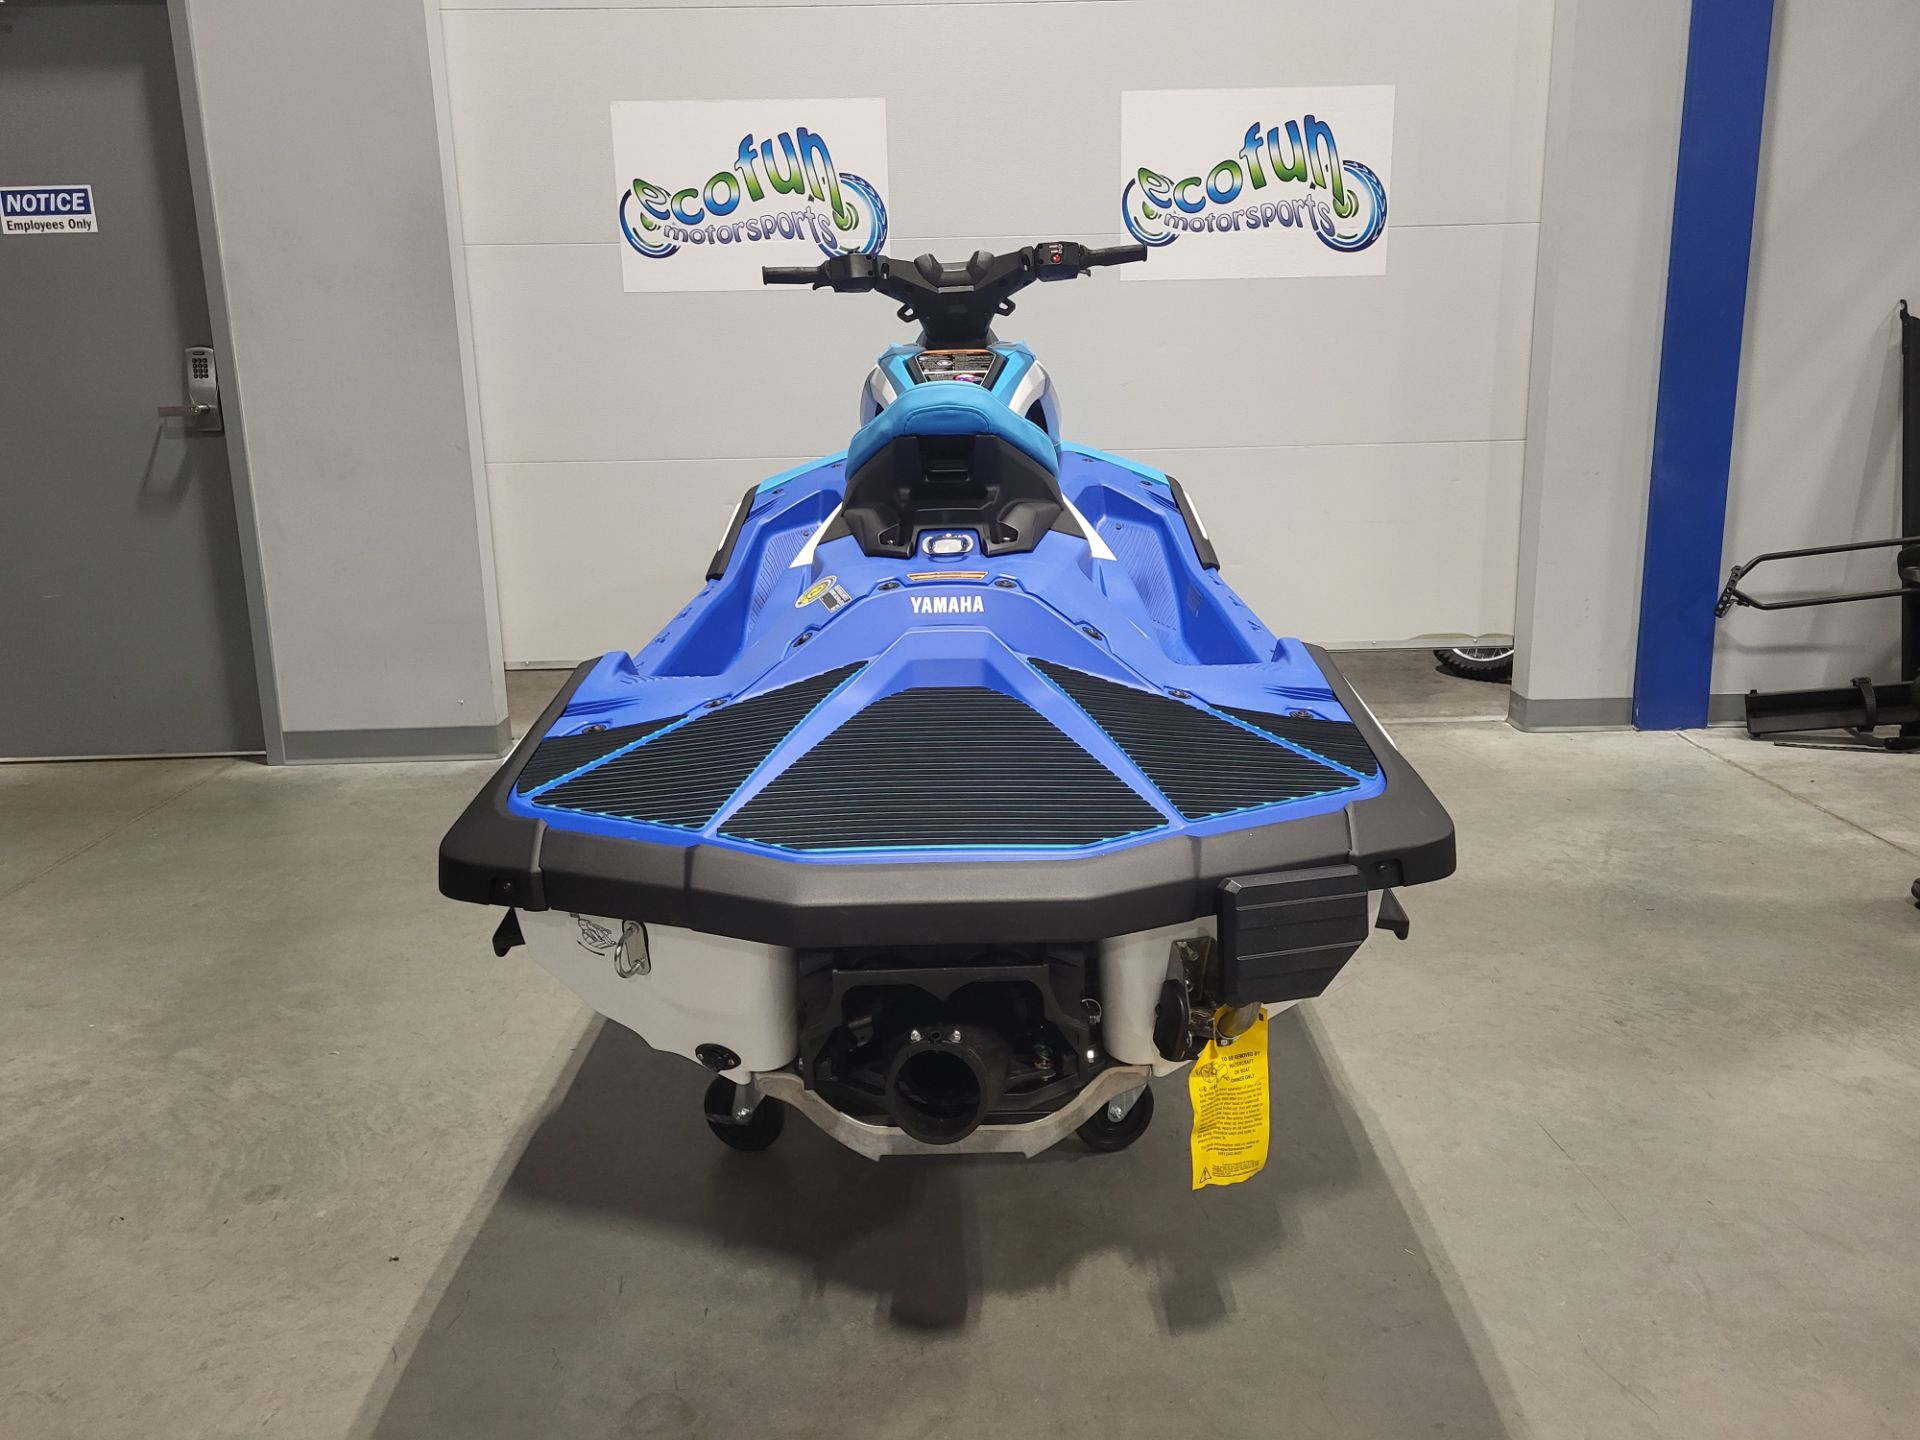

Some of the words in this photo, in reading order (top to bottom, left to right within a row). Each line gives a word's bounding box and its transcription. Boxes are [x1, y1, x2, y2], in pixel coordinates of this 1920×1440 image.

[7, 193, 85, 212] NOTICE
[7, 220, 65, 232] Employees
[68, 218, 92, 231] Only
[1164, 194, 1336, 237] motorsports
[664, 206, 838, 249] motorsports
[910, 596, 985, 614] YAMAHA
